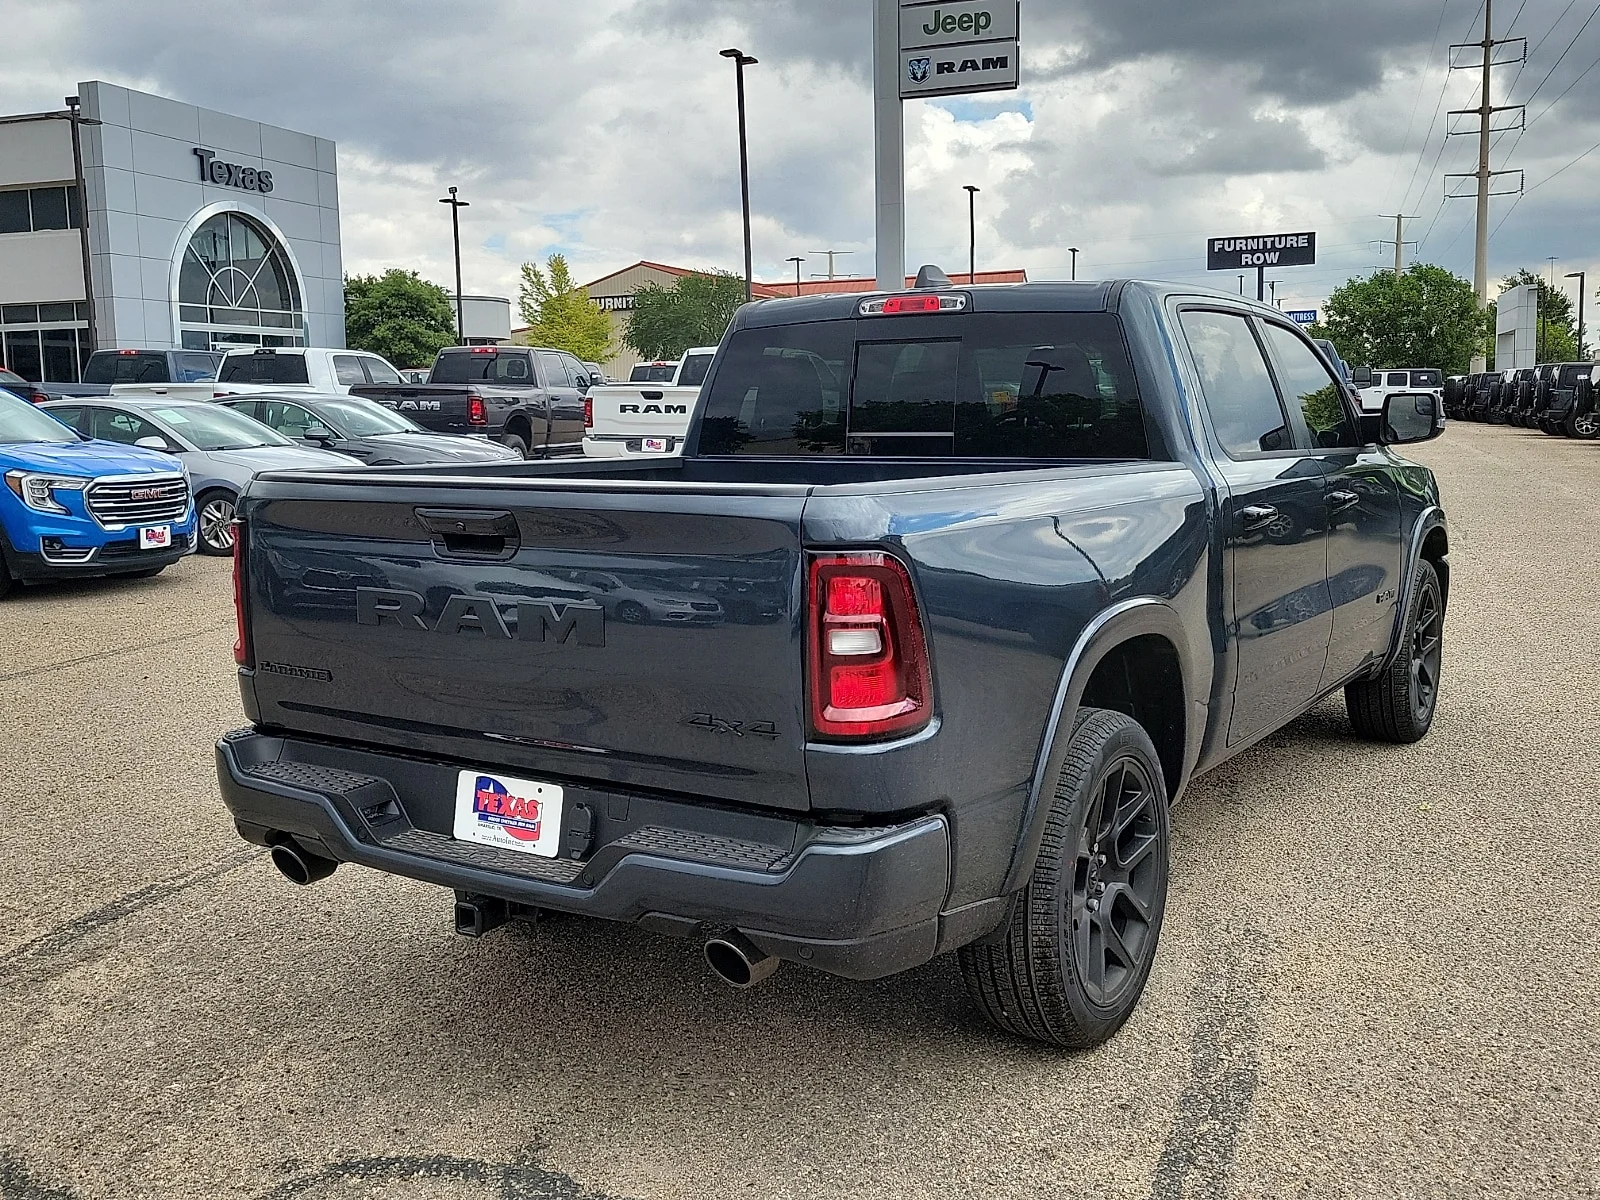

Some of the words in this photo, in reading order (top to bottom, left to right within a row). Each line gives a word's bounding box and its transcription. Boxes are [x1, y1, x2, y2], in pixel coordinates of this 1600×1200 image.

[923, 10, 991, 35] Jeep
[936, 56, 1008, 75] RAM
[193, 148, 274, 193] Texas
[1214, 235, 1309, 252] FURNITURE
[1241, 252, 1280, 266] ROW
[619, 405, 687, 414] RAM
[131, 488, 169, 500] GMC
[356, 586, 606, 648] RAM
[477, 790, 539, 820] TEXAS
